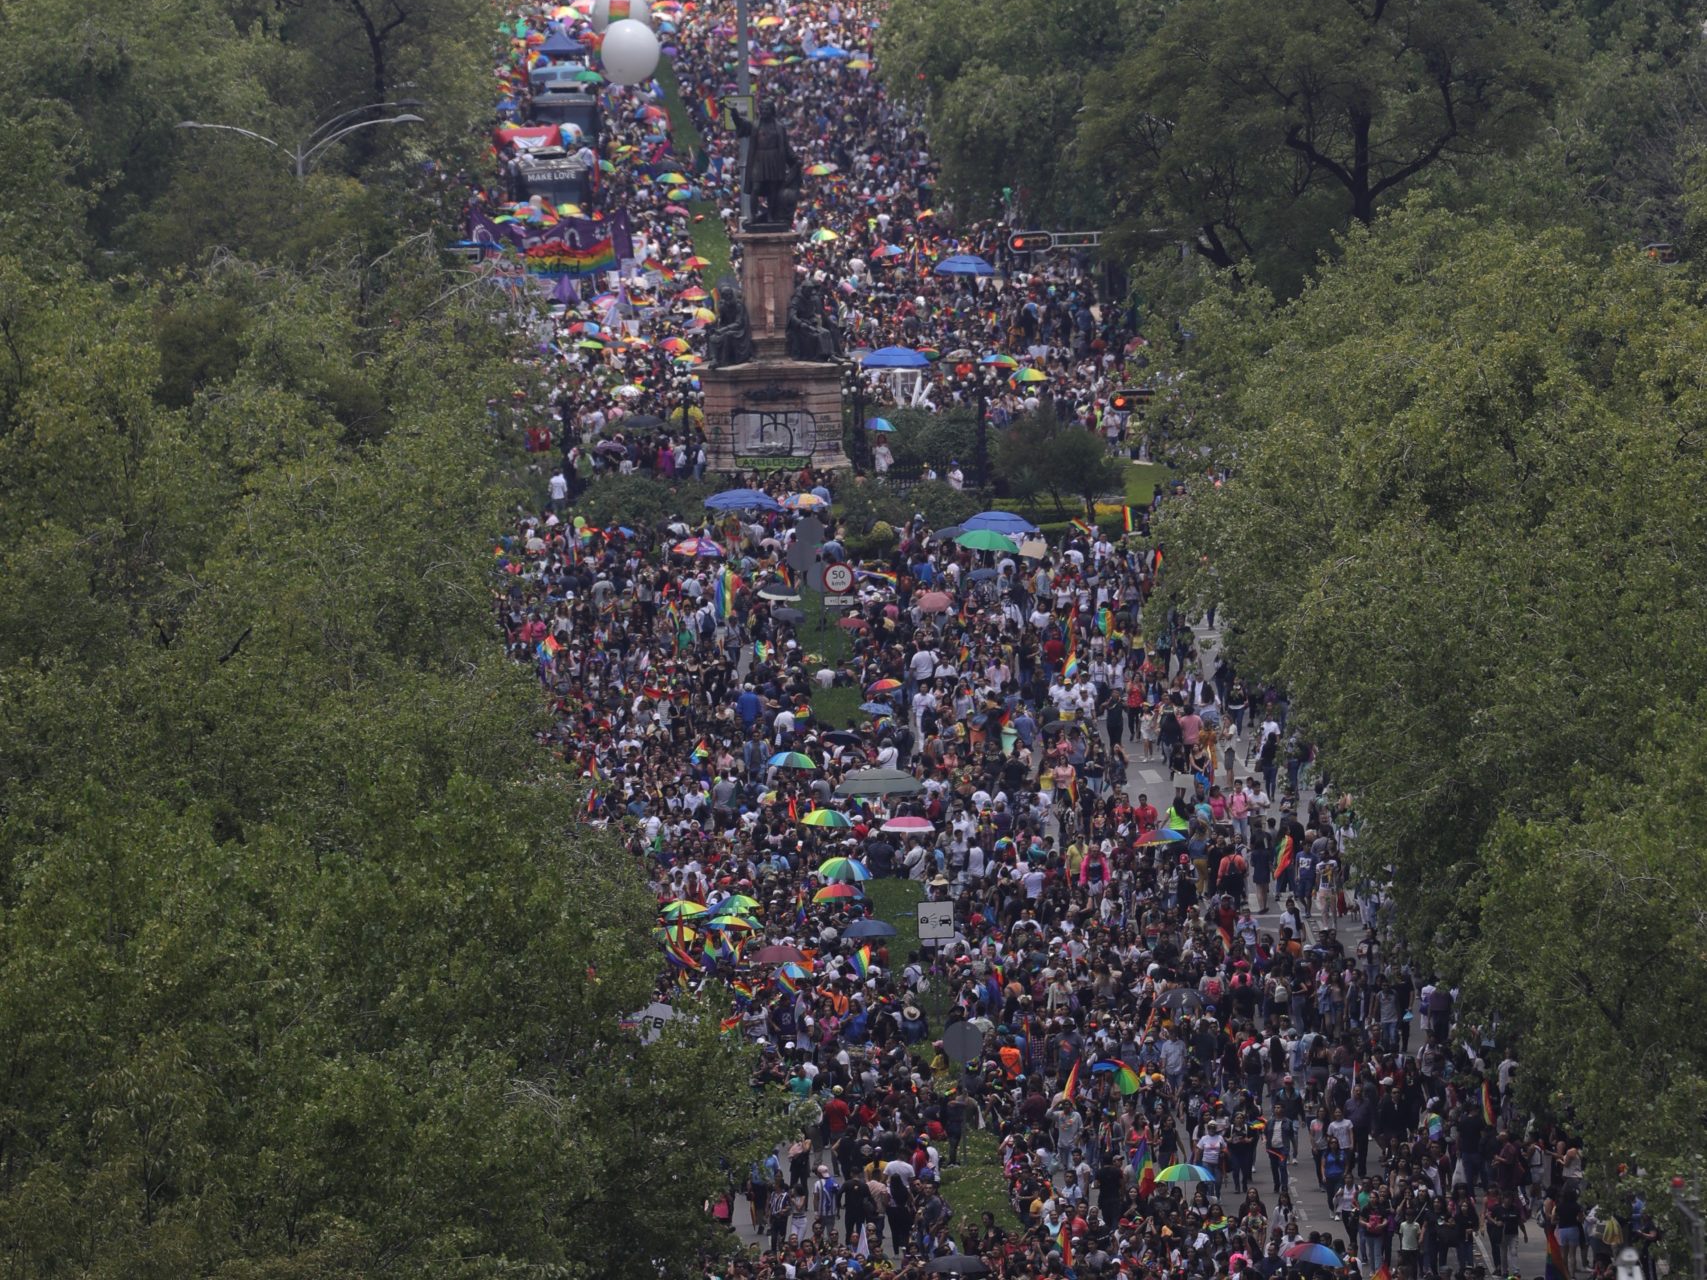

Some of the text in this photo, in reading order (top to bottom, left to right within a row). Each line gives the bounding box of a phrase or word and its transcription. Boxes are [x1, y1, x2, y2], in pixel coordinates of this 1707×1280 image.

[527, 169, 577, 182] MAKE LOVE
[831, 570, 846, 580] 50
